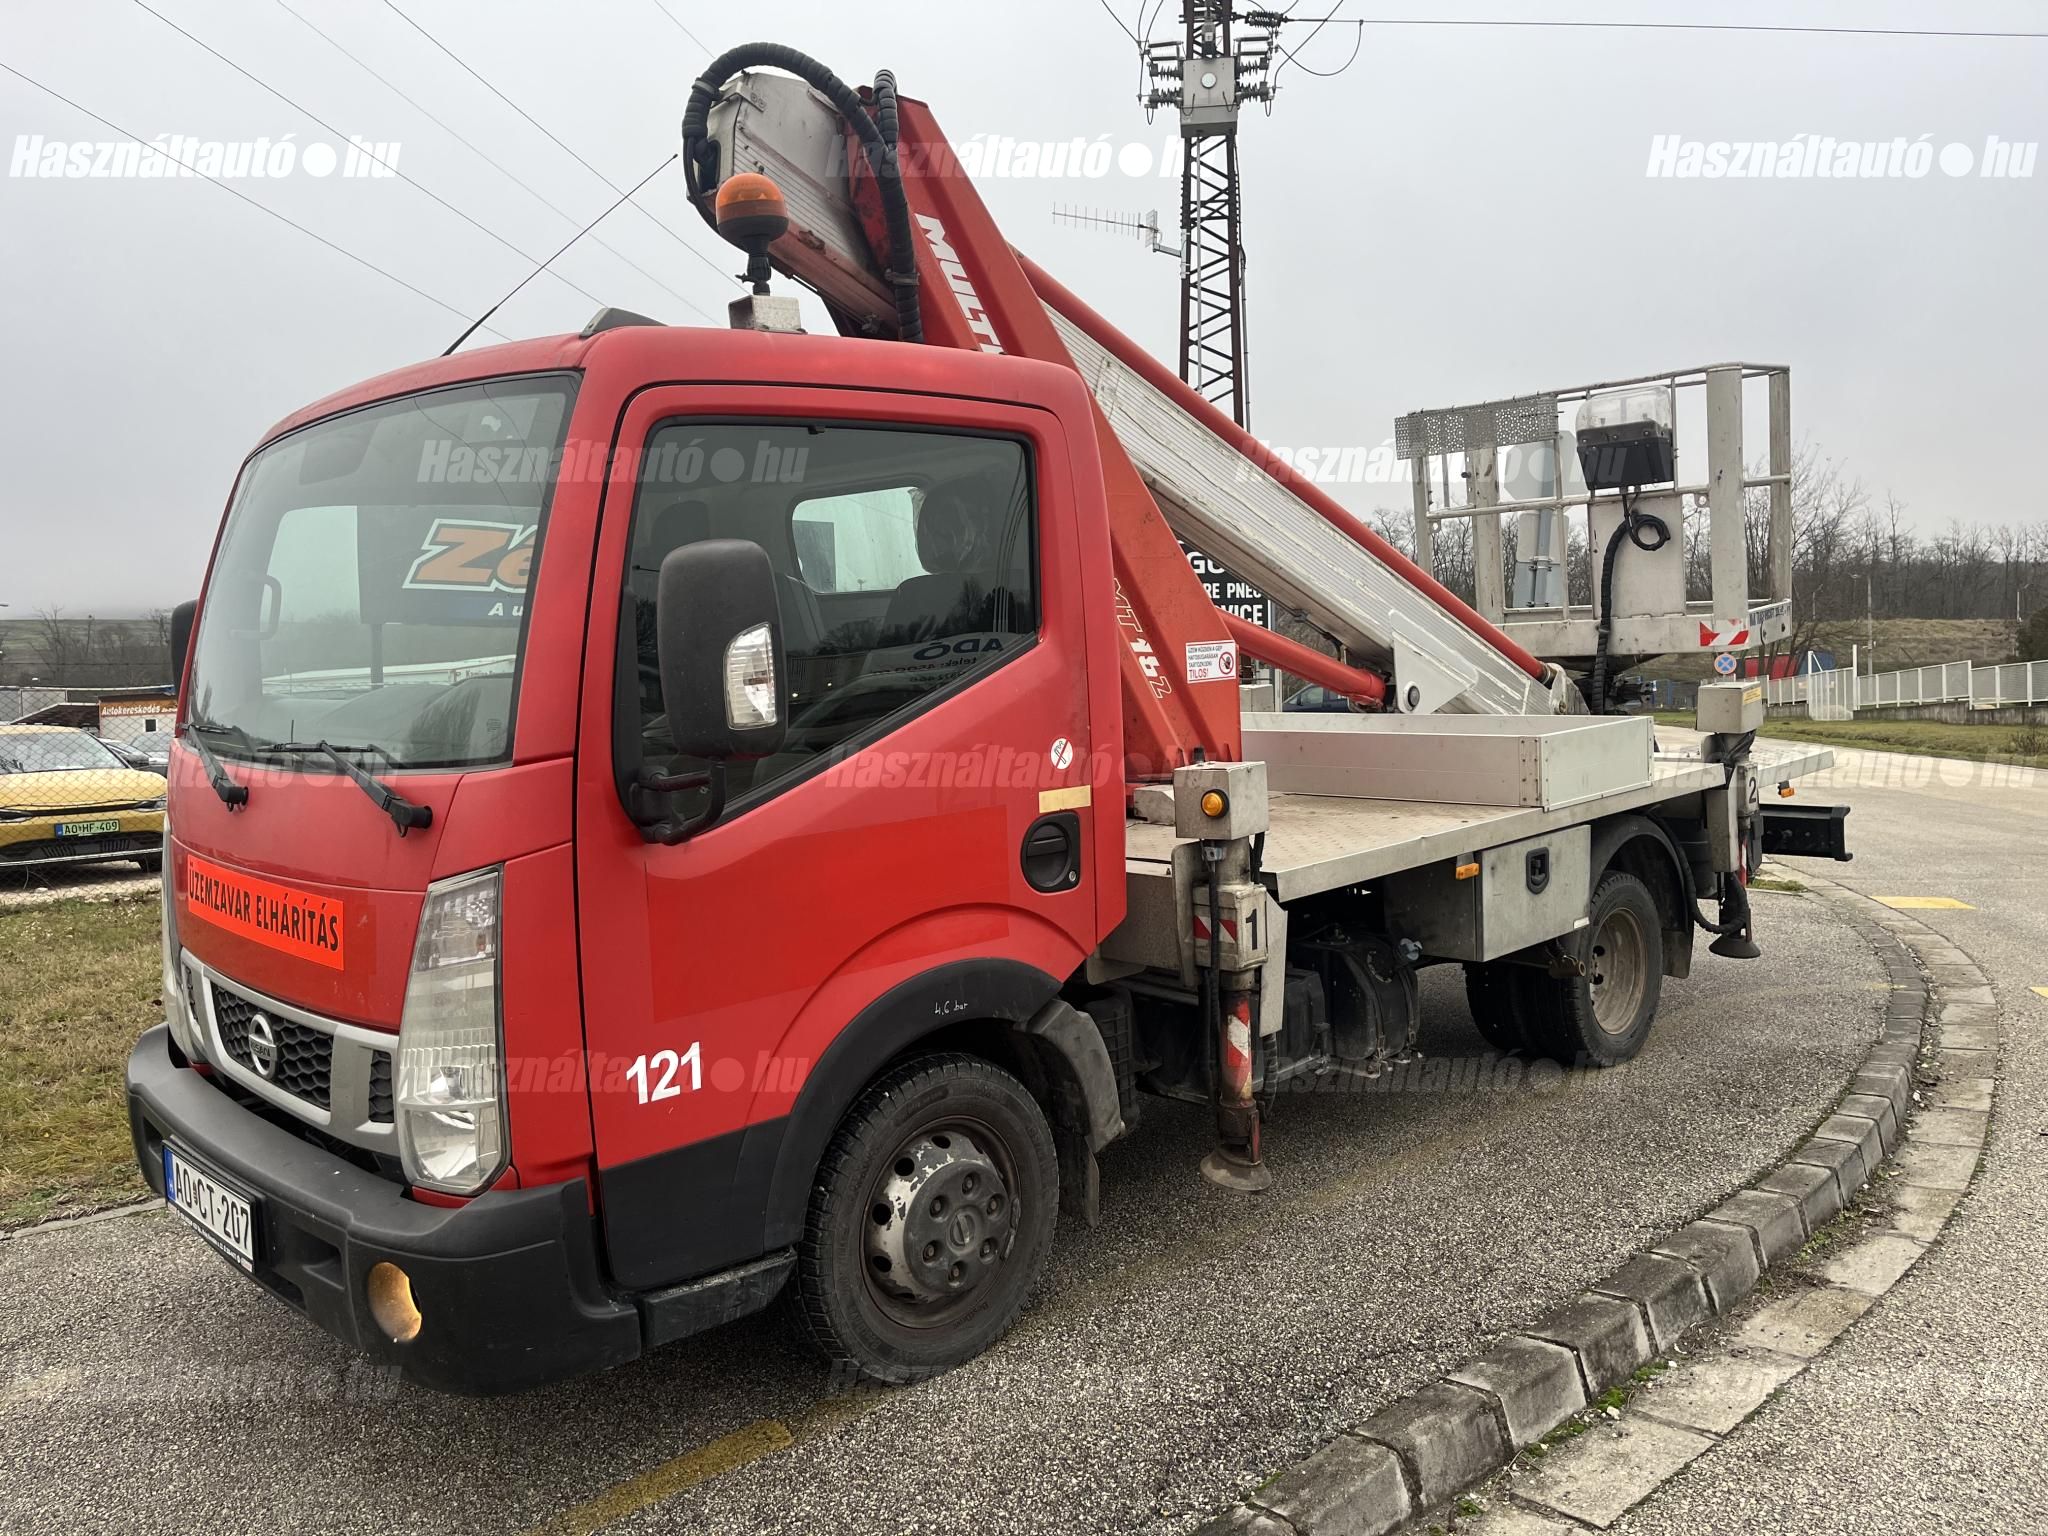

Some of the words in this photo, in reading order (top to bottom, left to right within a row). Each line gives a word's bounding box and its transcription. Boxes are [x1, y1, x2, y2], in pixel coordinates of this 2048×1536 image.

[1748, 776, 1757, 804] 2
[189, 861, 251, 924] ÜZEMZAVAR
[256, 893, 339, 951] ELHÁRÍTÁS
[1245, 908, 1258, 951] 1
[626, 1041, 702, 1105] 121
